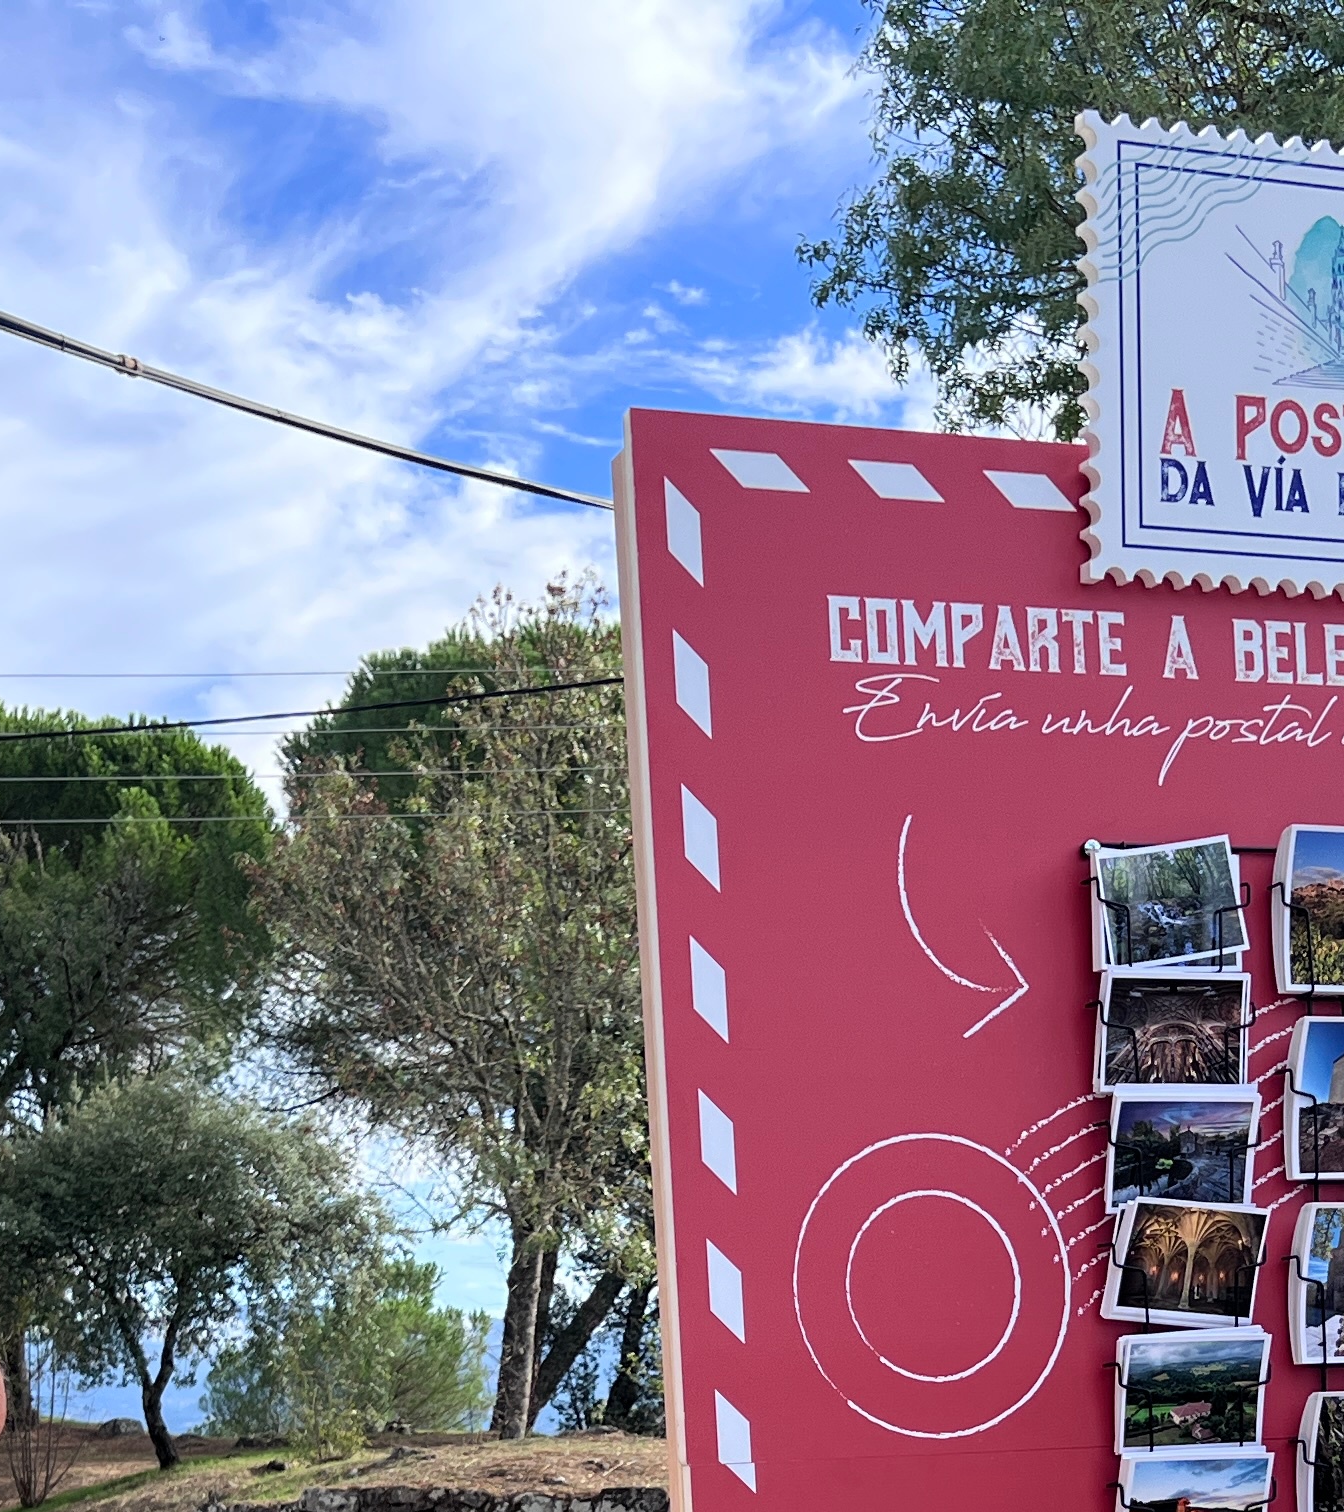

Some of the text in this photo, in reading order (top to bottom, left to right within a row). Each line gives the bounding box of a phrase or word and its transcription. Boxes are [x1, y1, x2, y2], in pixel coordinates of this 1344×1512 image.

[1159, 388, 1196, 458] A
[1159, 457, 1215, 507] DA
[1243, 455, 1310, 519] VÍA
[827, 595, 1127, 677] COMPARTE
[1163, 615, 1199, 680] A
[843, 674, 1029, 742] Envía
[1041, 686, 1170, 737] unha
[1156, 694, 1338, 787] postal
